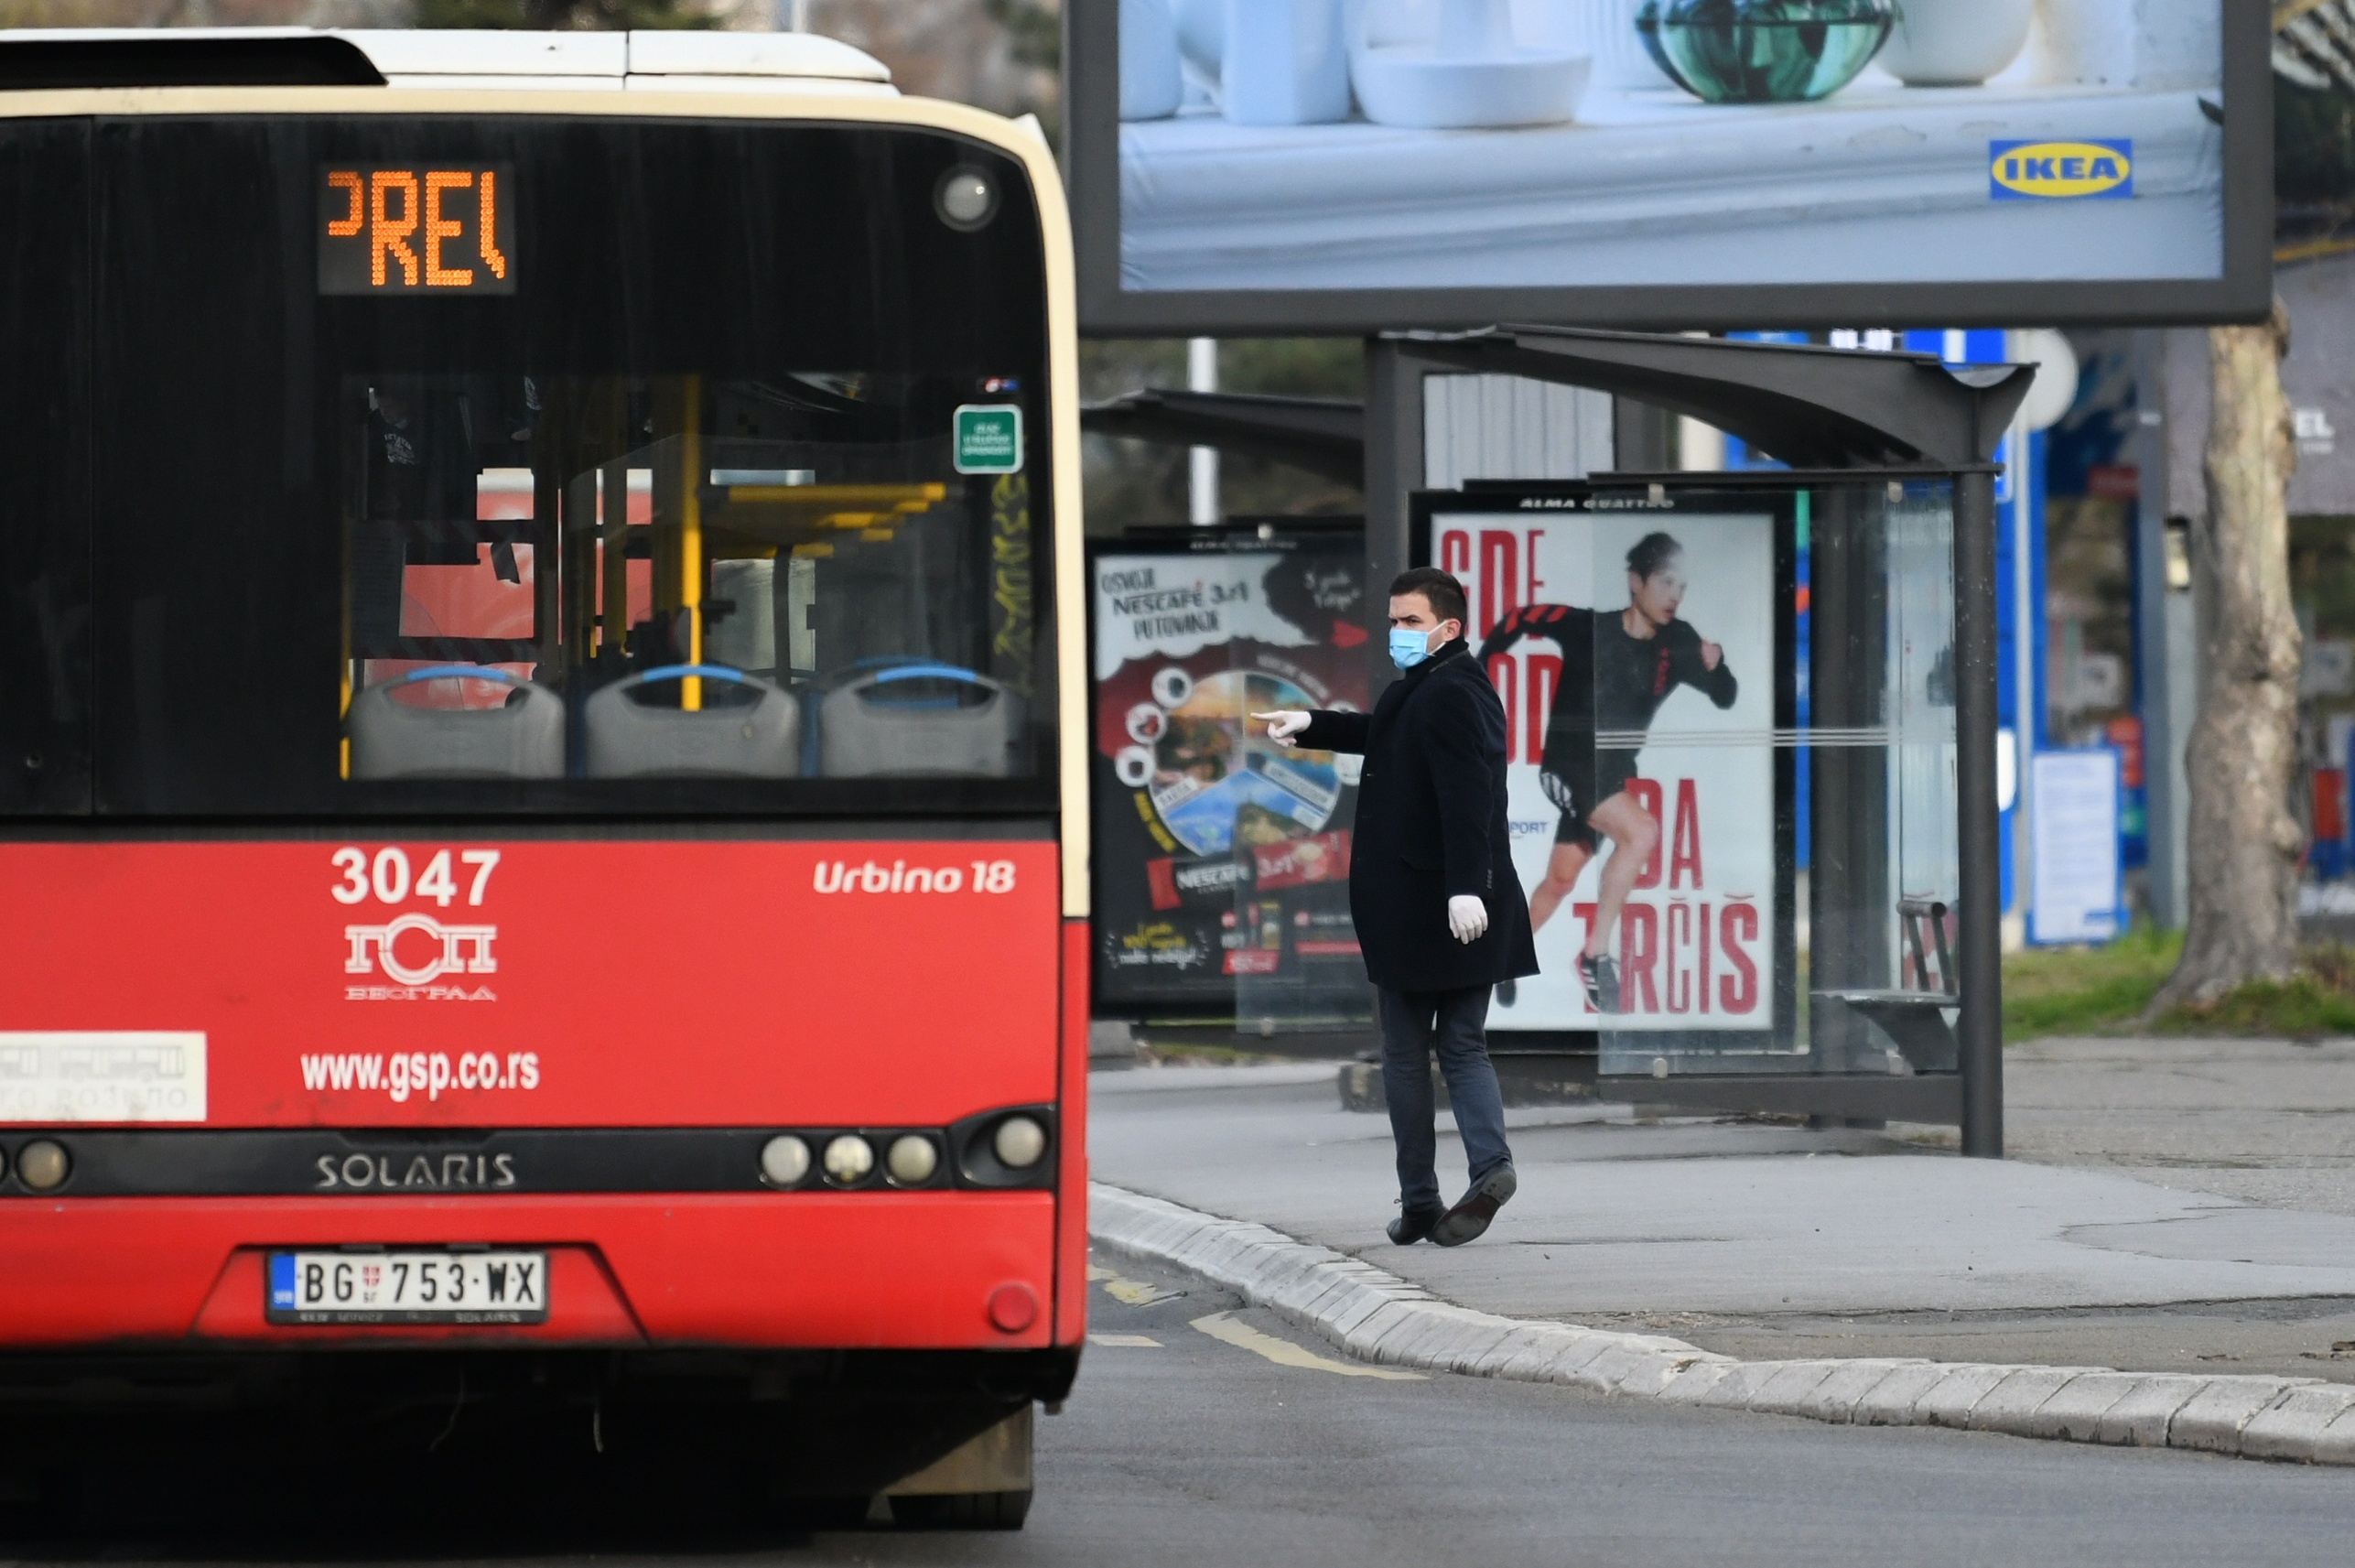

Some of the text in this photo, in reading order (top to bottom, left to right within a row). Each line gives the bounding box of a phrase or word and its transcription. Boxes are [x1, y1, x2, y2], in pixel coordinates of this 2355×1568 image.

[2004, 157, 2120, 180] IKEA
[1519, 497, 1575, 509] ALMA
[1509, 821, 1549, 834] PORT
[1625, 777, 1704, 891] DA
[330, 846, 502, 908] 3047
[813, 860, 1017, 894] Urbino 18
[344, 912, 498, 986] ГСП
[300, 1052, 540, 1103] www.gsp.co.rs
[315, 1152, 518, 1188] SOLARIS
[305, 1262, 353, 1303] BG
